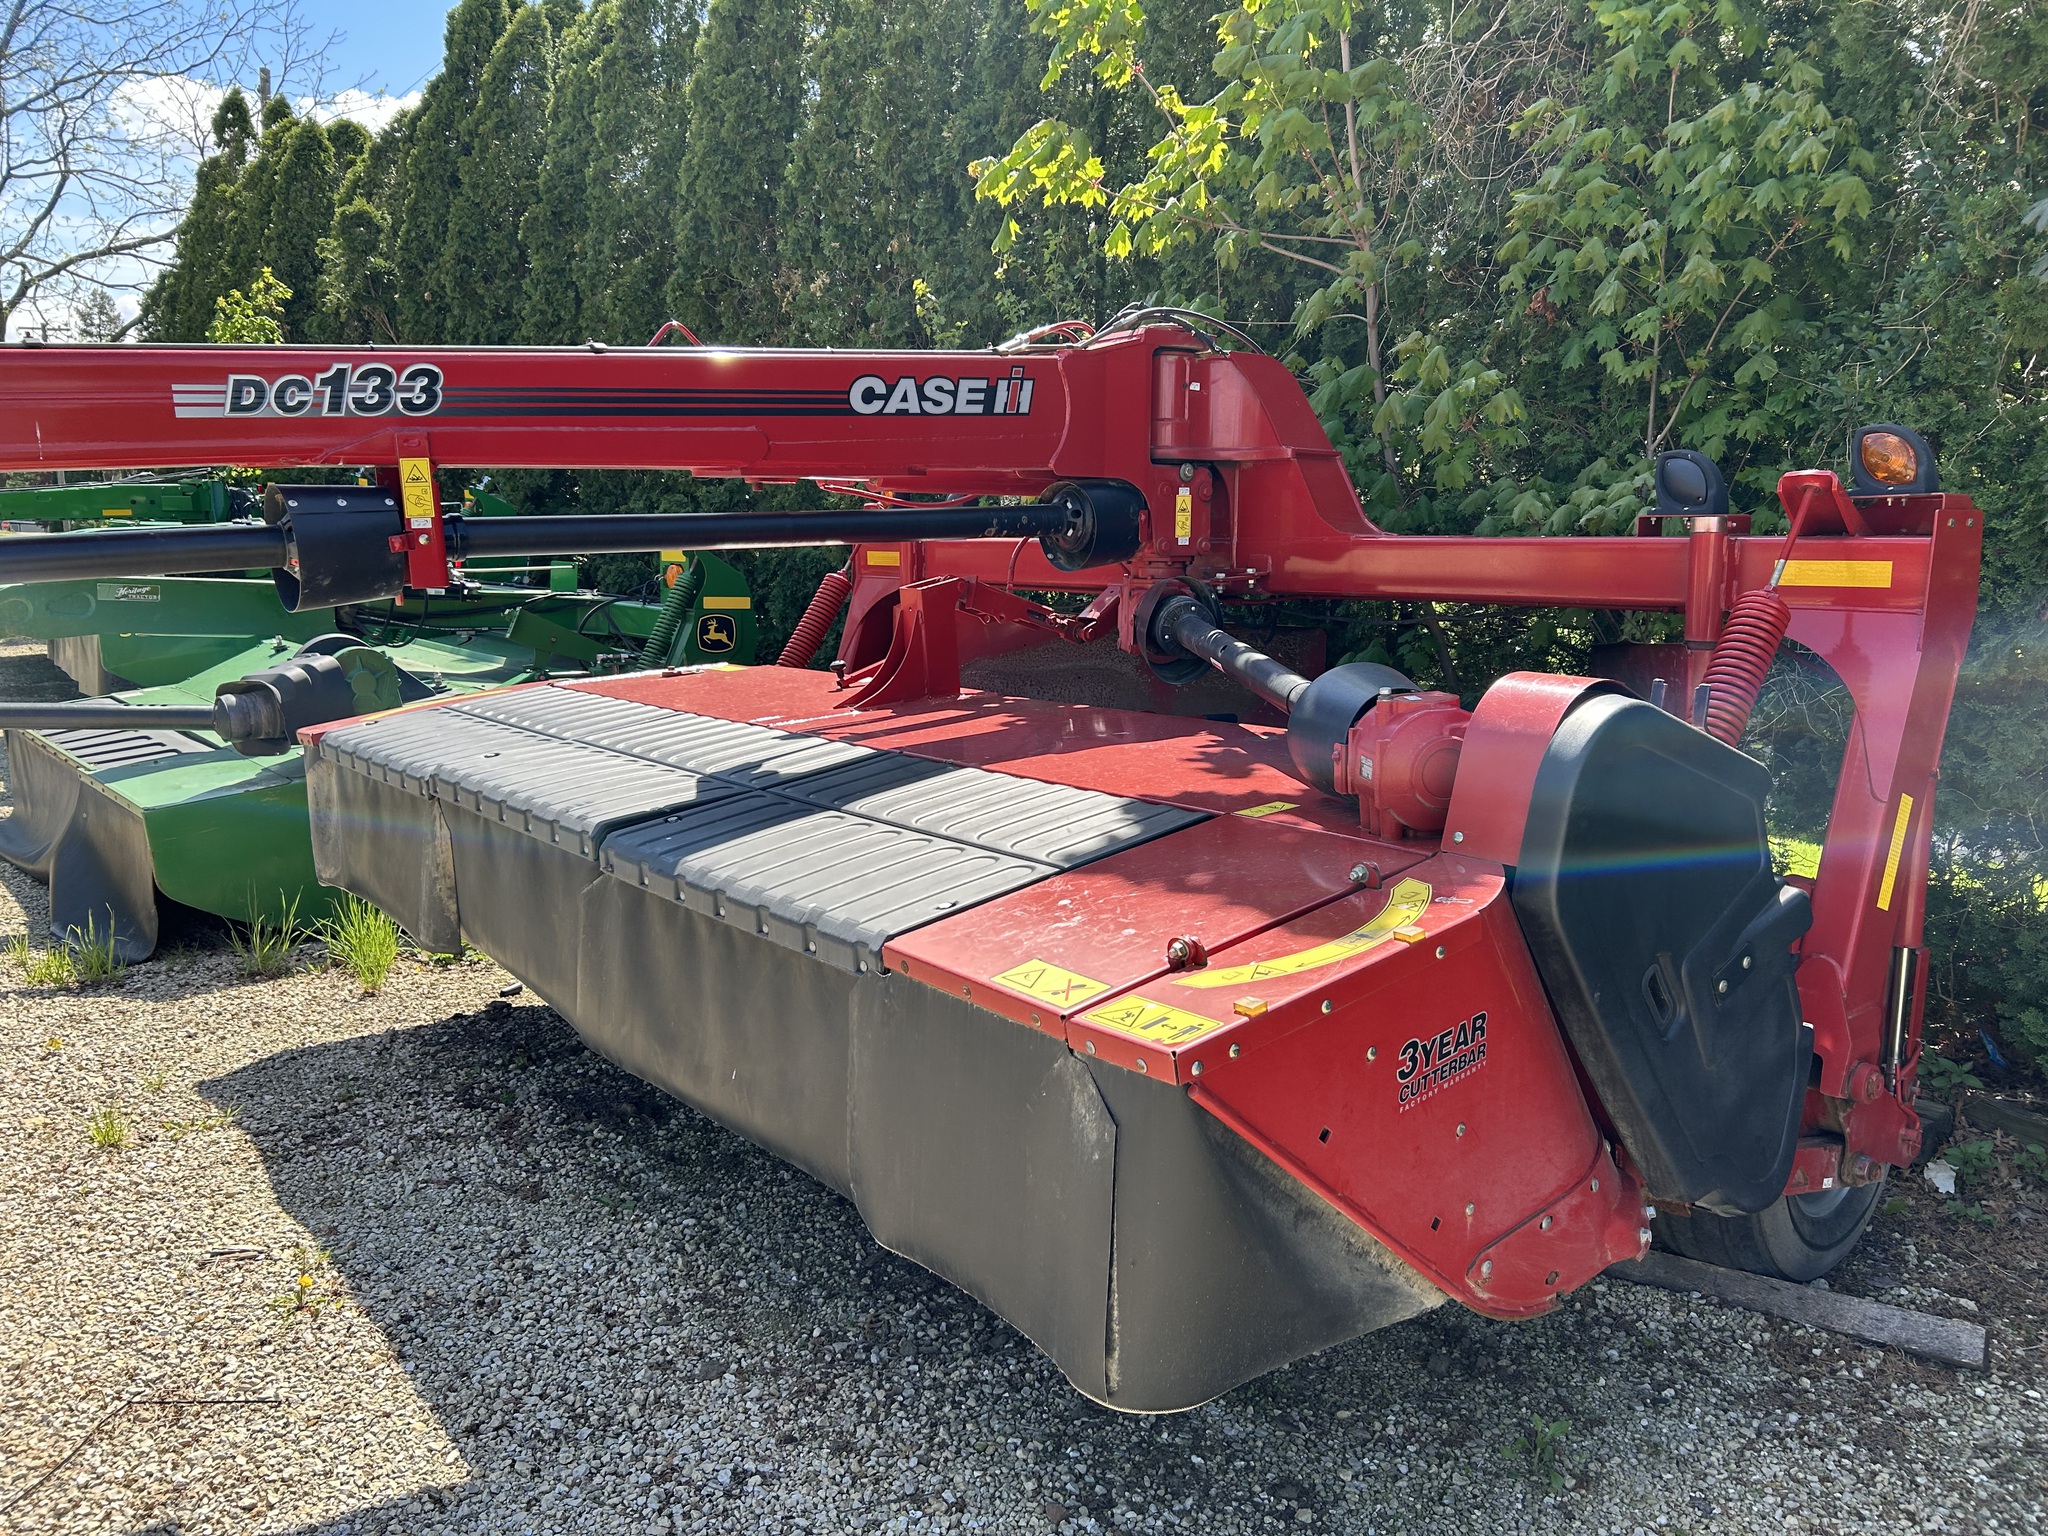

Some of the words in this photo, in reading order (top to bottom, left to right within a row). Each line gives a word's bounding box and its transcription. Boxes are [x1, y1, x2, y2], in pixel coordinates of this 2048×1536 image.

[224, 363, 443, 417] DC133
[849, 375, 987, 415] CASE
[1399, 1042, 1487, 1104] CUTTERBAR
[1400, 1087, 1438, 1113] FACTORY
[1443, 1060, 1487, 1090] WARRANTY
